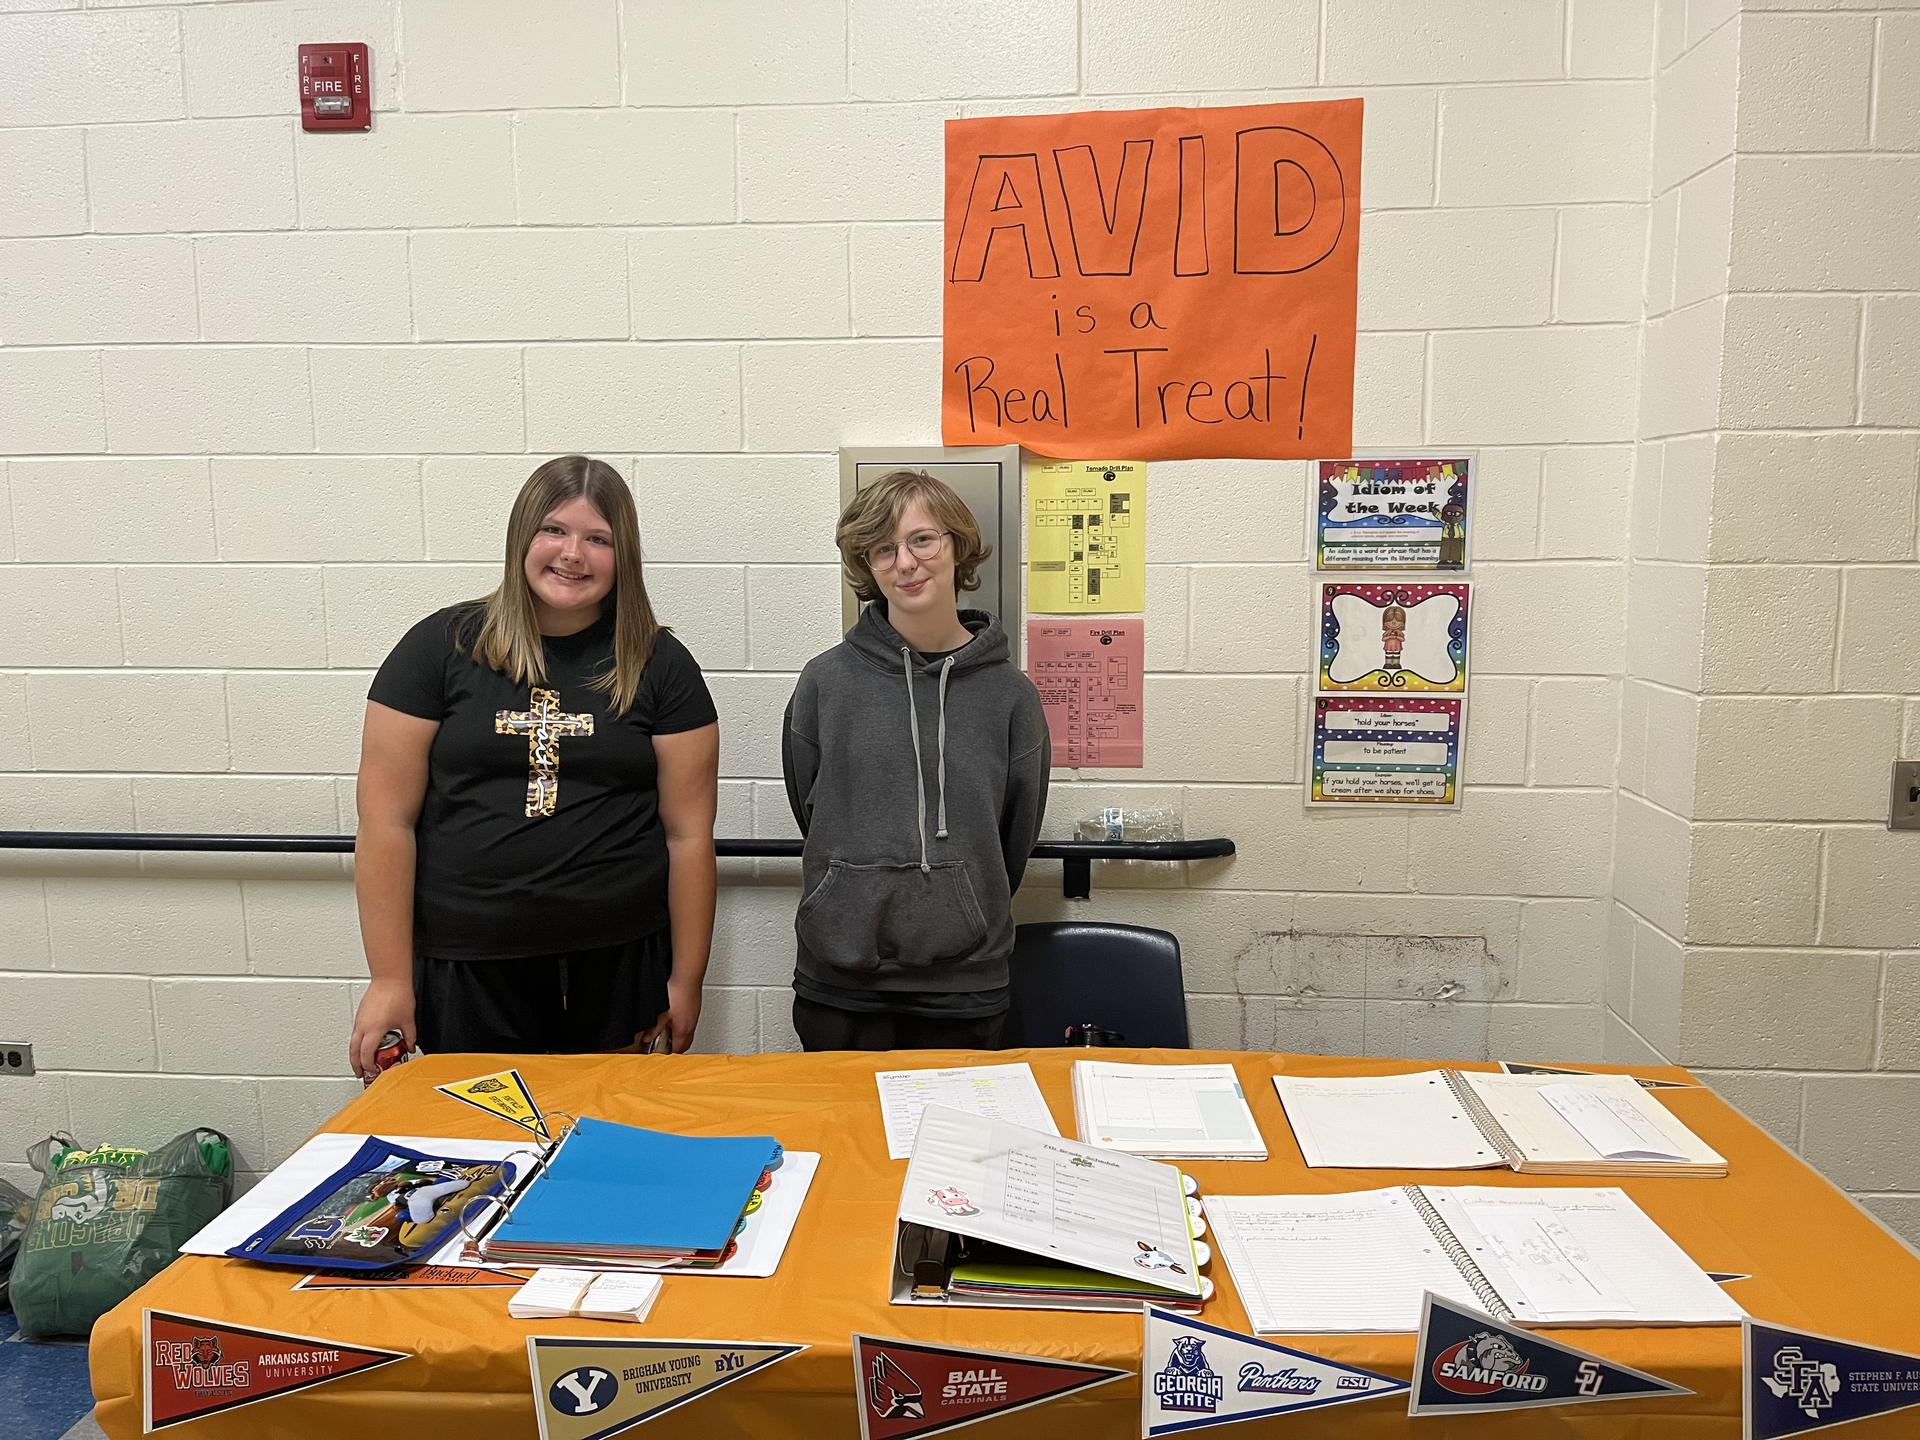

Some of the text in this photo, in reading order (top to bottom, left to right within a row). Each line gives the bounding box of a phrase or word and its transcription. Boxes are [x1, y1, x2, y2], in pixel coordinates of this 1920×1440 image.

[302, 55, 310, 95] FIRE
[353, 54, 362, 94] FIRE
[314, 81, 343, 92] FIRE
[949, 126, 1345, 284] AVID
[1051, 294, 1168, 336] is a
[954, 334, 1317, 441] Real Treat!
[1352, 483, 1436, 496] Idiom of
[1345, 501, 1440, 514] the Week
[155, 1340, 193, 1366] RED
[258, 1350, 340, 1366] ARKANSAS STATE
[714, 1352, 745, 1373] BYU
[172, 1360, 251, 1390] WOLVES
[265, 1365, 333, 1378] UNIVERSITY
[622, 1354, 702, 1381] BRIGHAM YOUNG
[948, 1368, 1002, 1383] BALL
[1238, 1361, 1321, 1395] Panthers
[1440, 1362, 1548, 1393] SAMFORD
[1849, 1371, 1920, 1380] STEPHEN F. AU
[556, 1369, 608, 1413] Y
[635, 1372, 692, 1394] UNIVERSITY
[942, 1381, 1008, 1398] STATE
[1155, 1374, 1223, 1397] GEORGIA
[1337, 1376, 1370, 1390] GSU
[1850, 1382, 1920, 1392] STATE UNIVER
[940, 1394, 1007, 1406] CARDINALS
[1162, 1393, 1215, 1409] STATE
